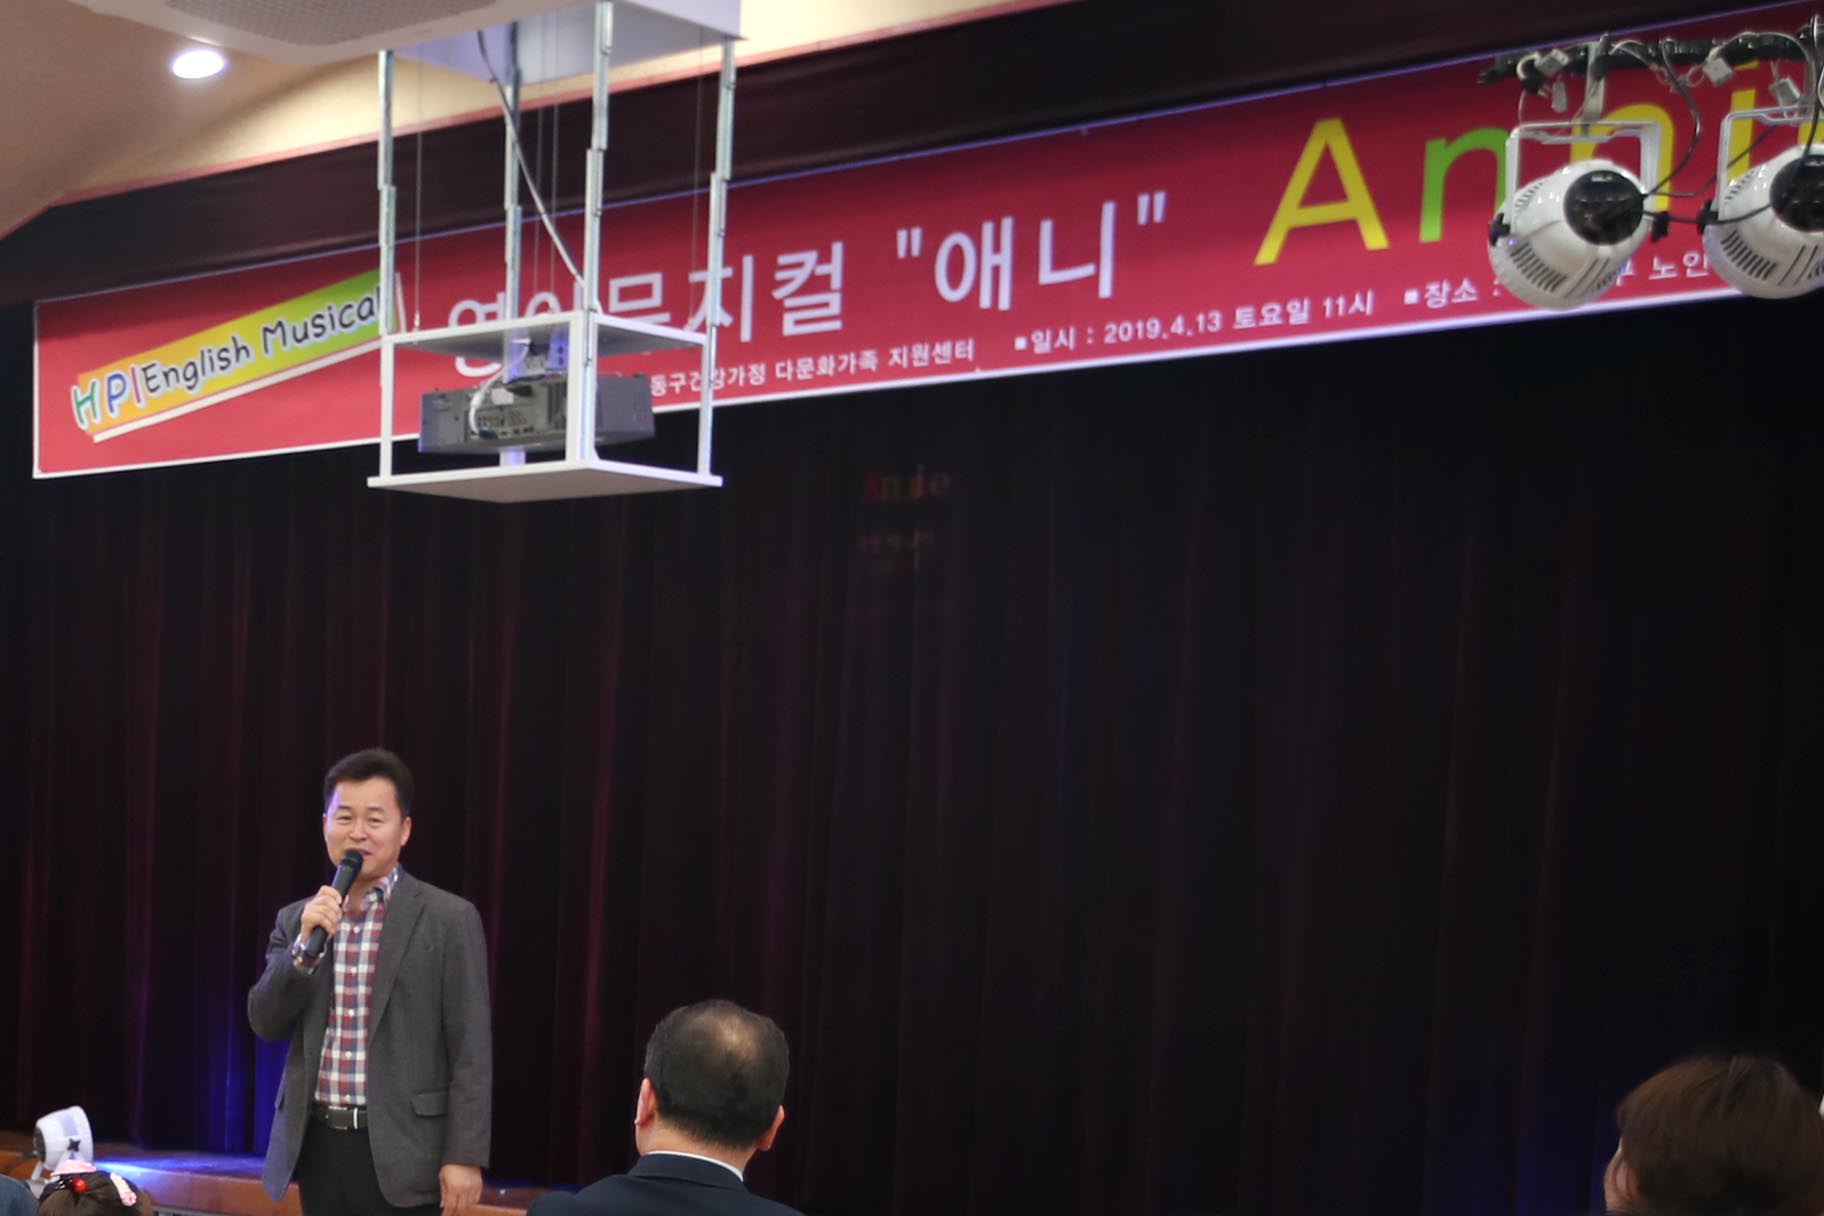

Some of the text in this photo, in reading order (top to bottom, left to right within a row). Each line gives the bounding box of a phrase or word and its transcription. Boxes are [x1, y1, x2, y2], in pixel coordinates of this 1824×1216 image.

[1103, 310, 1222, 345] 2019.4.13
[1232, 298, 1311, 330] 토요일
[1322, 289, 1375, 319] 11시
[141, 336, 251, 394] English
[776, 348, 878, 382] 다문화가족
[888, 338, 975, 368] 지원센터
